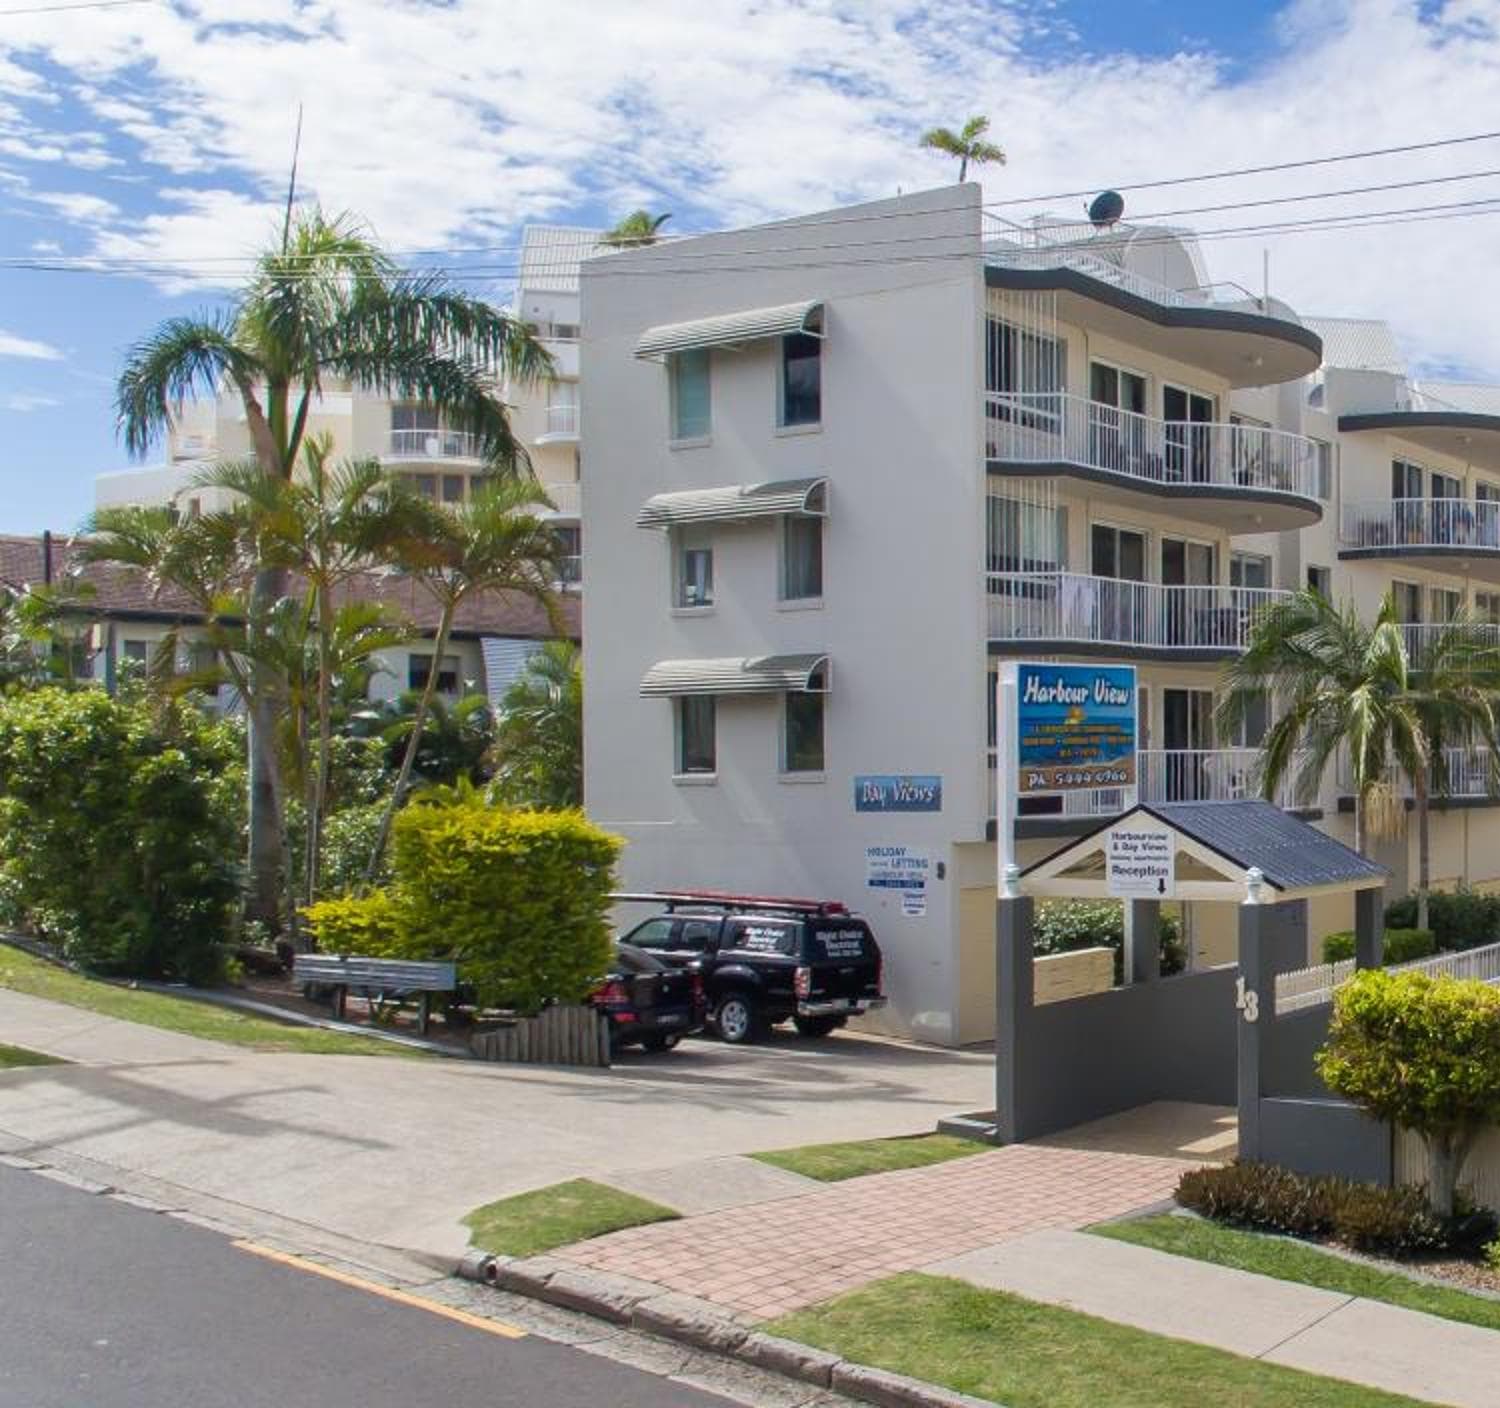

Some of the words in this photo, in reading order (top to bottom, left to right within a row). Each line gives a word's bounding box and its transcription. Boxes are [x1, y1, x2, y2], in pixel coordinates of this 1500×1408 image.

[1024, 675, 1089, 704] Harbour
[1094, 678, 1129, 704] View
[863, 781, 887, 807] Bay
[893, 779, 935, 803] Views
[867, 847, 907, 857] HOLIDAY
[890, 858, 929, 868] LETTING
[1111, 865, 1169, 879] Reception
[1236, 976, 1258, 1022] 13
